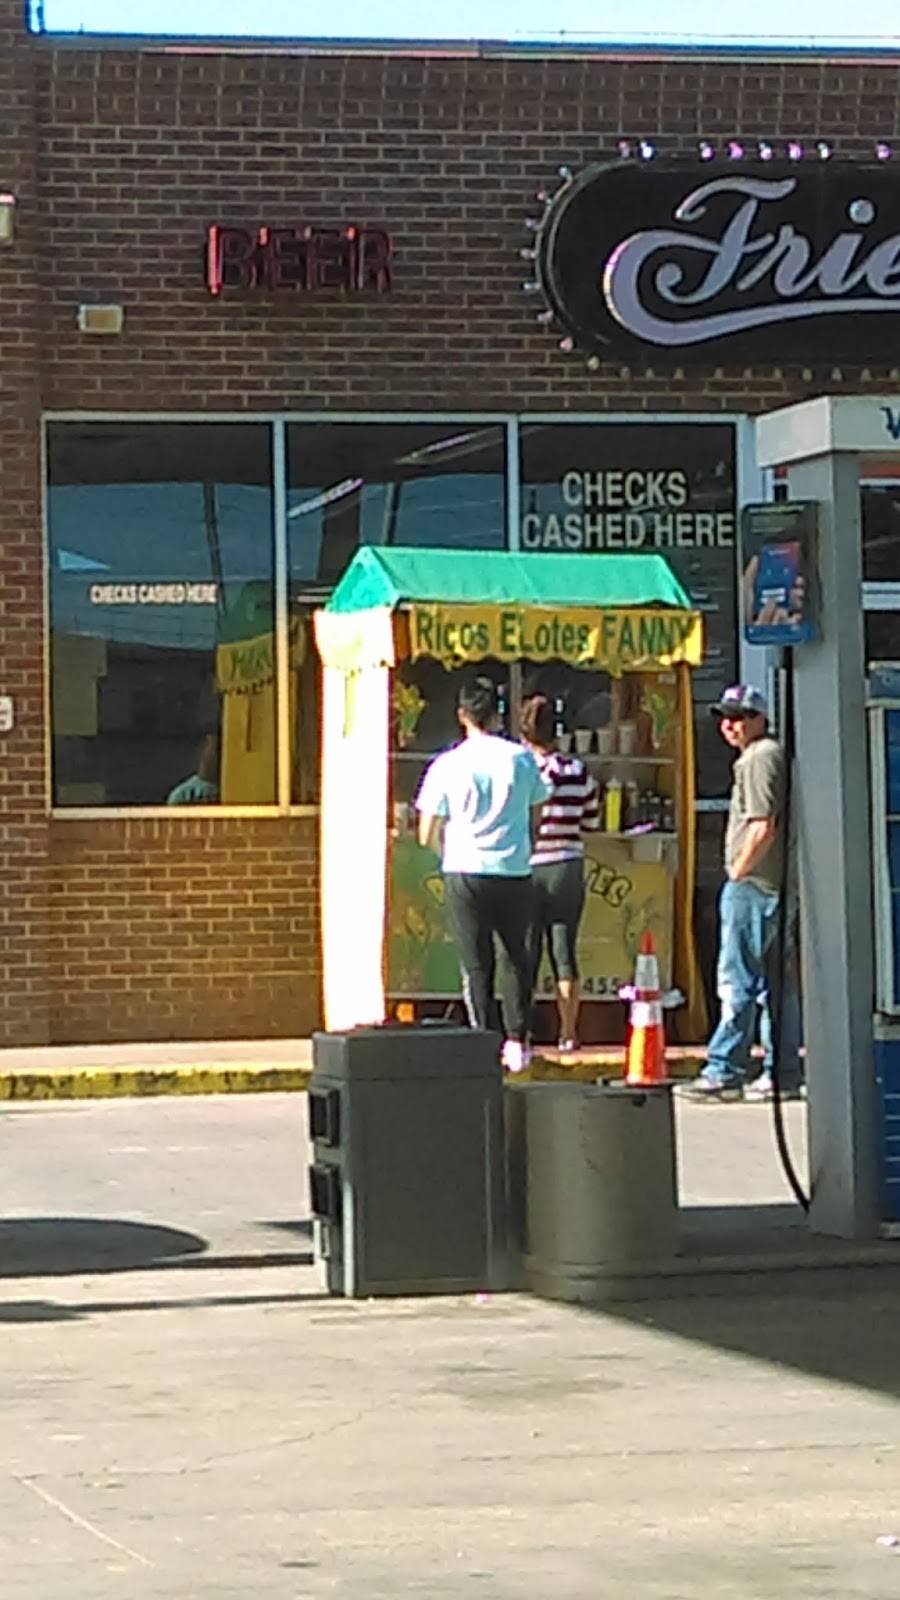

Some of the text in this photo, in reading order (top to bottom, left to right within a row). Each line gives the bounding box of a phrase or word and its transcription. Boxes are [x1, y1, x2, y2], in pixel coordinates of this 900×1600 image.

[206, 224, 392, 294] BEER
[562, 471, 688, 507] CHECKS
[522, 513, 734, 547] CASHED HERE
[90, 583, 218, 603] CHECKS CASHED HERE
[416, 609, 490, 651] Ricos
[602, 613, 697, 656] FANNY
